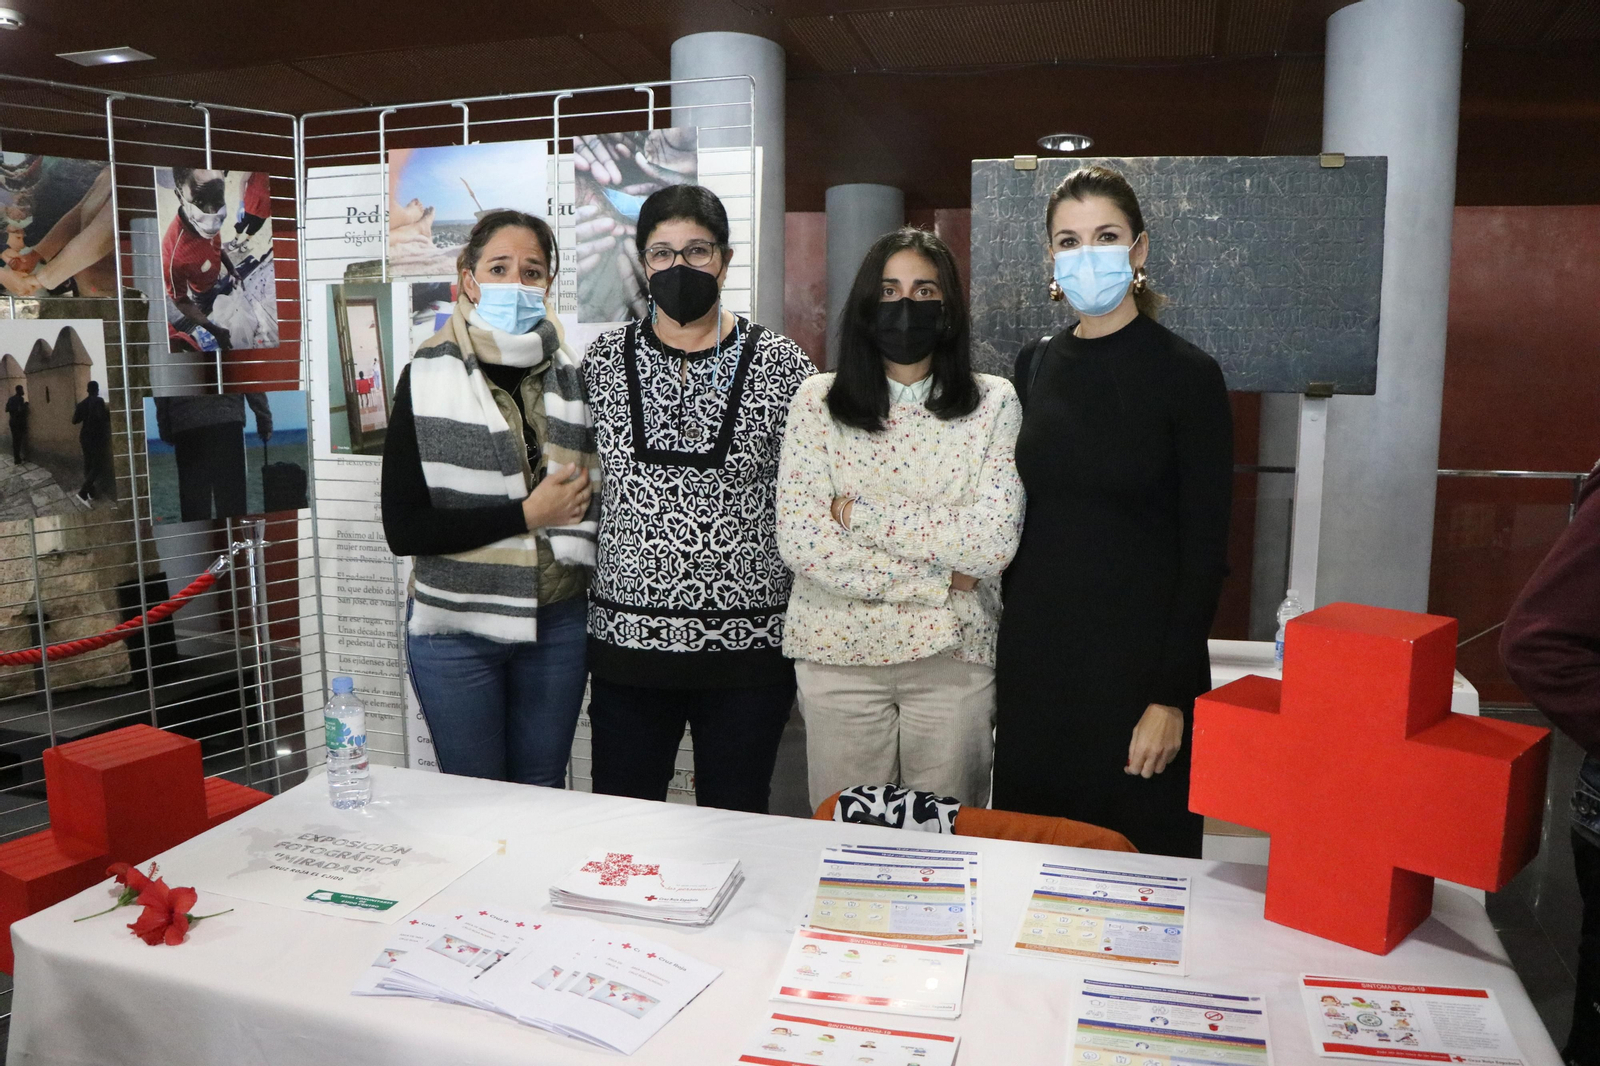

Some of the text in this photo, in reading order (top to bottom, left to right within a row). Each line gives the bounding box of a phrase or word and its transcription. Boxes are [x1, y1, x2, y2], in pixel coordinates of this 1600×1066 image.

[344, 230, 375, 247] Siglo
[337, 530, 367, 540] Próximo
[337, 543, 389, 553] mujer romana,
[348, 586, 361, 595] que
[363, 586, 384, 595] debió
[338, 625, 356, 634] Unas
[357, 626, 385, 637] décadas
[338, 637, 345, 645] el
[346, 638, 376, 648] pedestal
[339, 653, 352, 663] Los
[352, 655, 385, 667] ejidenses
[297, 833, 412, 855] EXPOSICIÓN
[273, 841, 401, 867] FOTOGRÁFICA
[274, 851, 375, 875] "MIRADAS"
[269, 864, 289, 872] CRUZ
[289, 867, 309, 875] ROJA
[320, 873, 345, 881] EJIDO
[490, 914, 503, 922] Cruz
[658, 956, 688, 972] Cruz Roja
